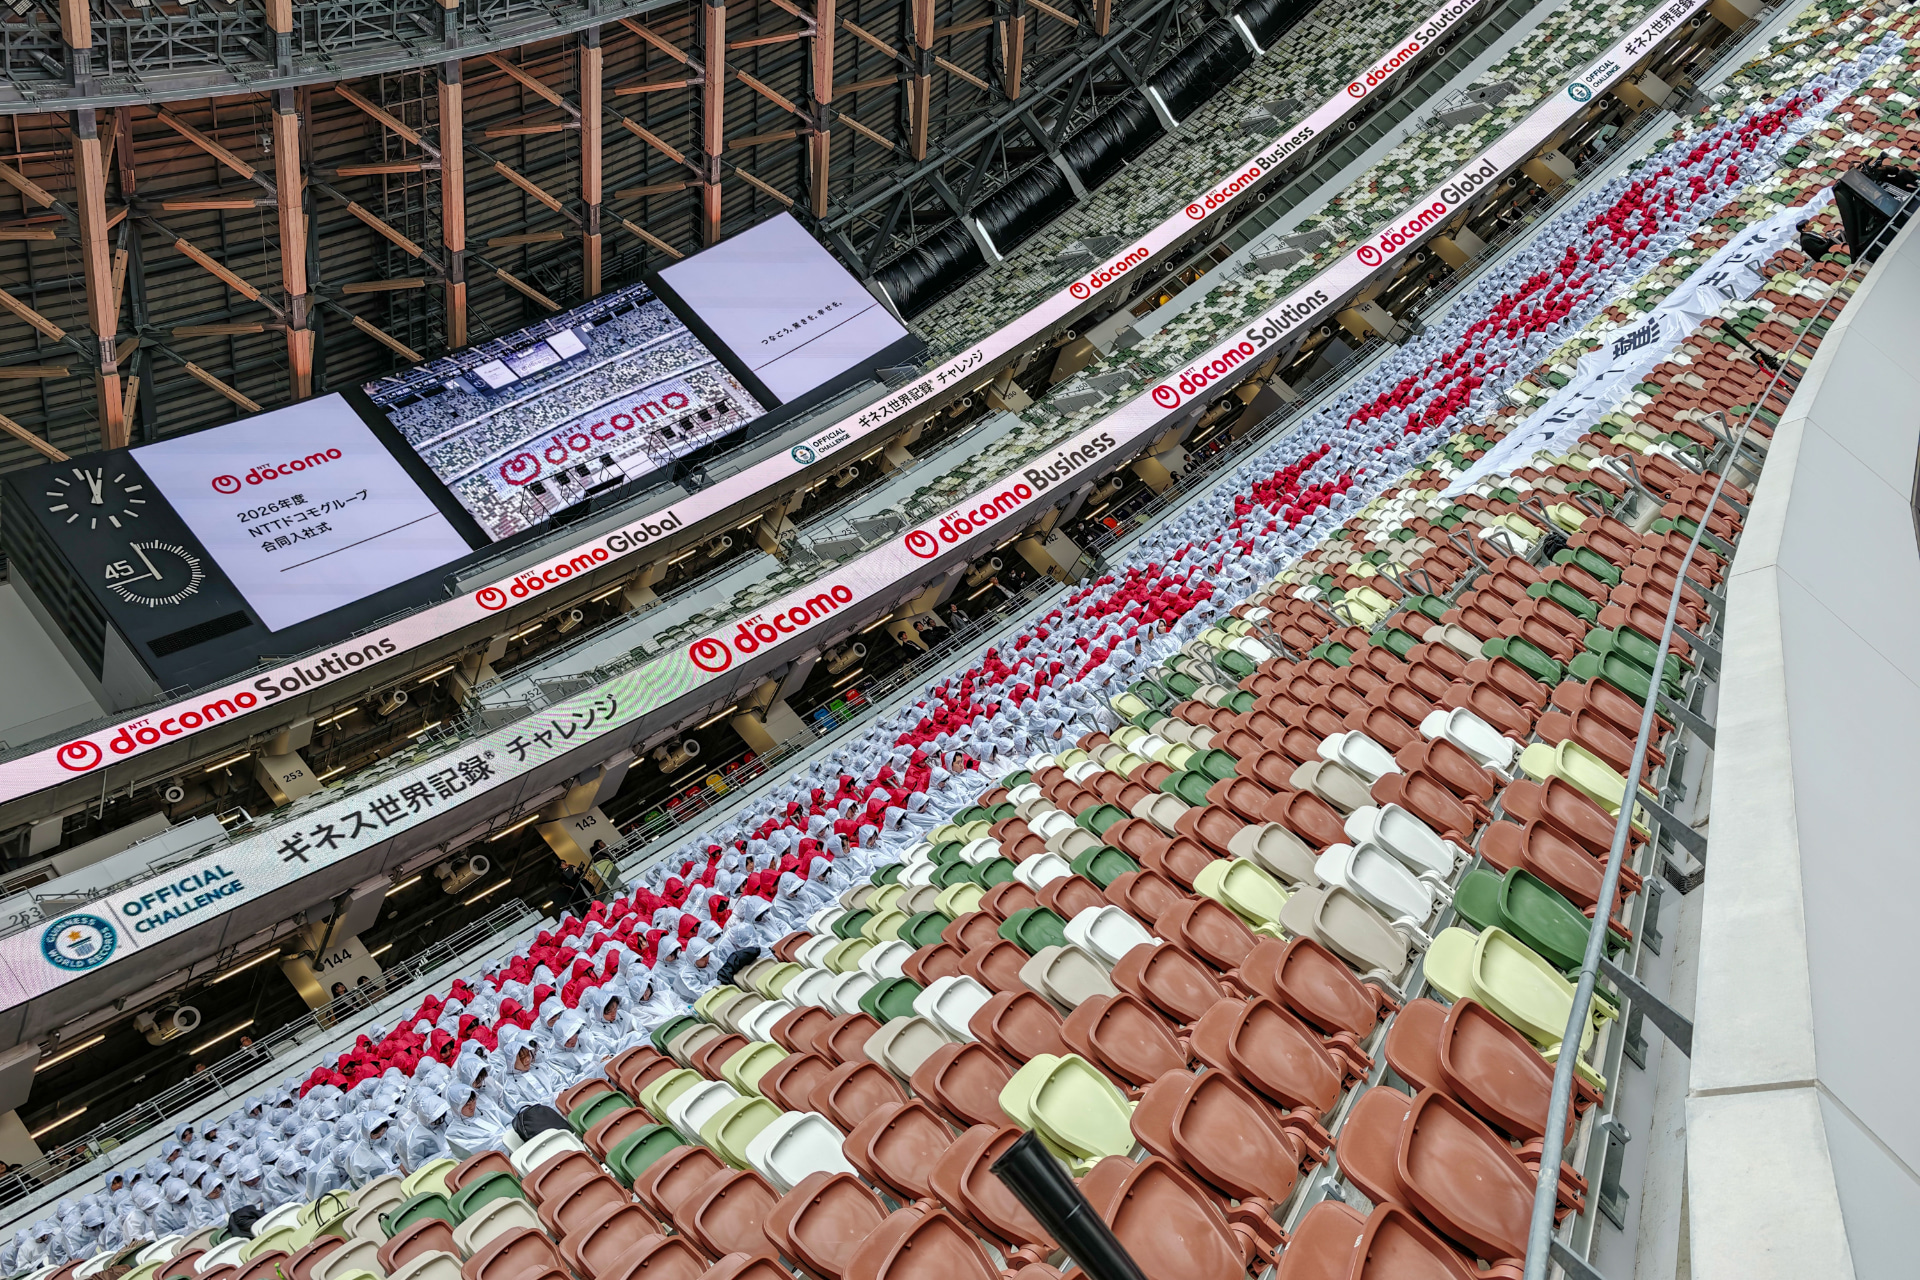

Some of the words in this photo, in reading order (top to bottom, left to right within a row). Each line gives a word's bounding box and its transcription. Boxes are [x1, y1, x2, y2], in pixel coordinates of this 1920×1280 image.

[1366, 42, 1420, 86] docomo
[1585, 59, 1615, 83] OFFICIAL
[1593, 64, 1621, 88] CHALLENGE
[1205, 167, 1261, 209] docomo
[1254, 126, 1315, 170] Business
[1380, 202, 1447, 253] docomo
[1440, 157, 1499, 204] Global
[1090, 247, 1149, 288] docomo
[1179, 341, 1254, 395] docomo
[1246, 289, 1329, 348] Solutions
[936, 349, 984, 384] チャレンジ
[544, 391, 689, 465] docomo
[812, 427, 846, 448] OFFICIAL
[818, 433, 851, 454] CHALLENGE
[245, 448, 342, 485] docomo
[938, 483, 1033, 543] docomo
[1022, 432, 1117, 491] Business
[237, 493, 309, 523] 2026年度
[248, 489, 368, 538] NTTドコモグループ
[946, 510, 960, 521] NTT
[261, 521, 333, 552] 合同入社式
[105, 560, 134, 579] 45
[510, 547, 609, 598] docomo
[606, 510, 683, 553] Global
[520, 570, 535, 580] NTT
[734, 585, 853, 653] docomo
[744, 614, 763, 628] NTT
[110, 692, 257, 754] docomo
[254, 637, 397, 701] Solutions
[521, 687, 541, 702] 252
[128, 718, 150, 731] NTT
[505, 693, 617, 763] チャレンジ
[283, 769, 304, 783] 253
[575, 815, 597, 831] 143
[122, 865, 234, 917] OFFICIAL
[134, 879, 245, 933] CHALLENGE
[48, 948, 84, 968] WORLD
[324, 948, 352, 968] 144
